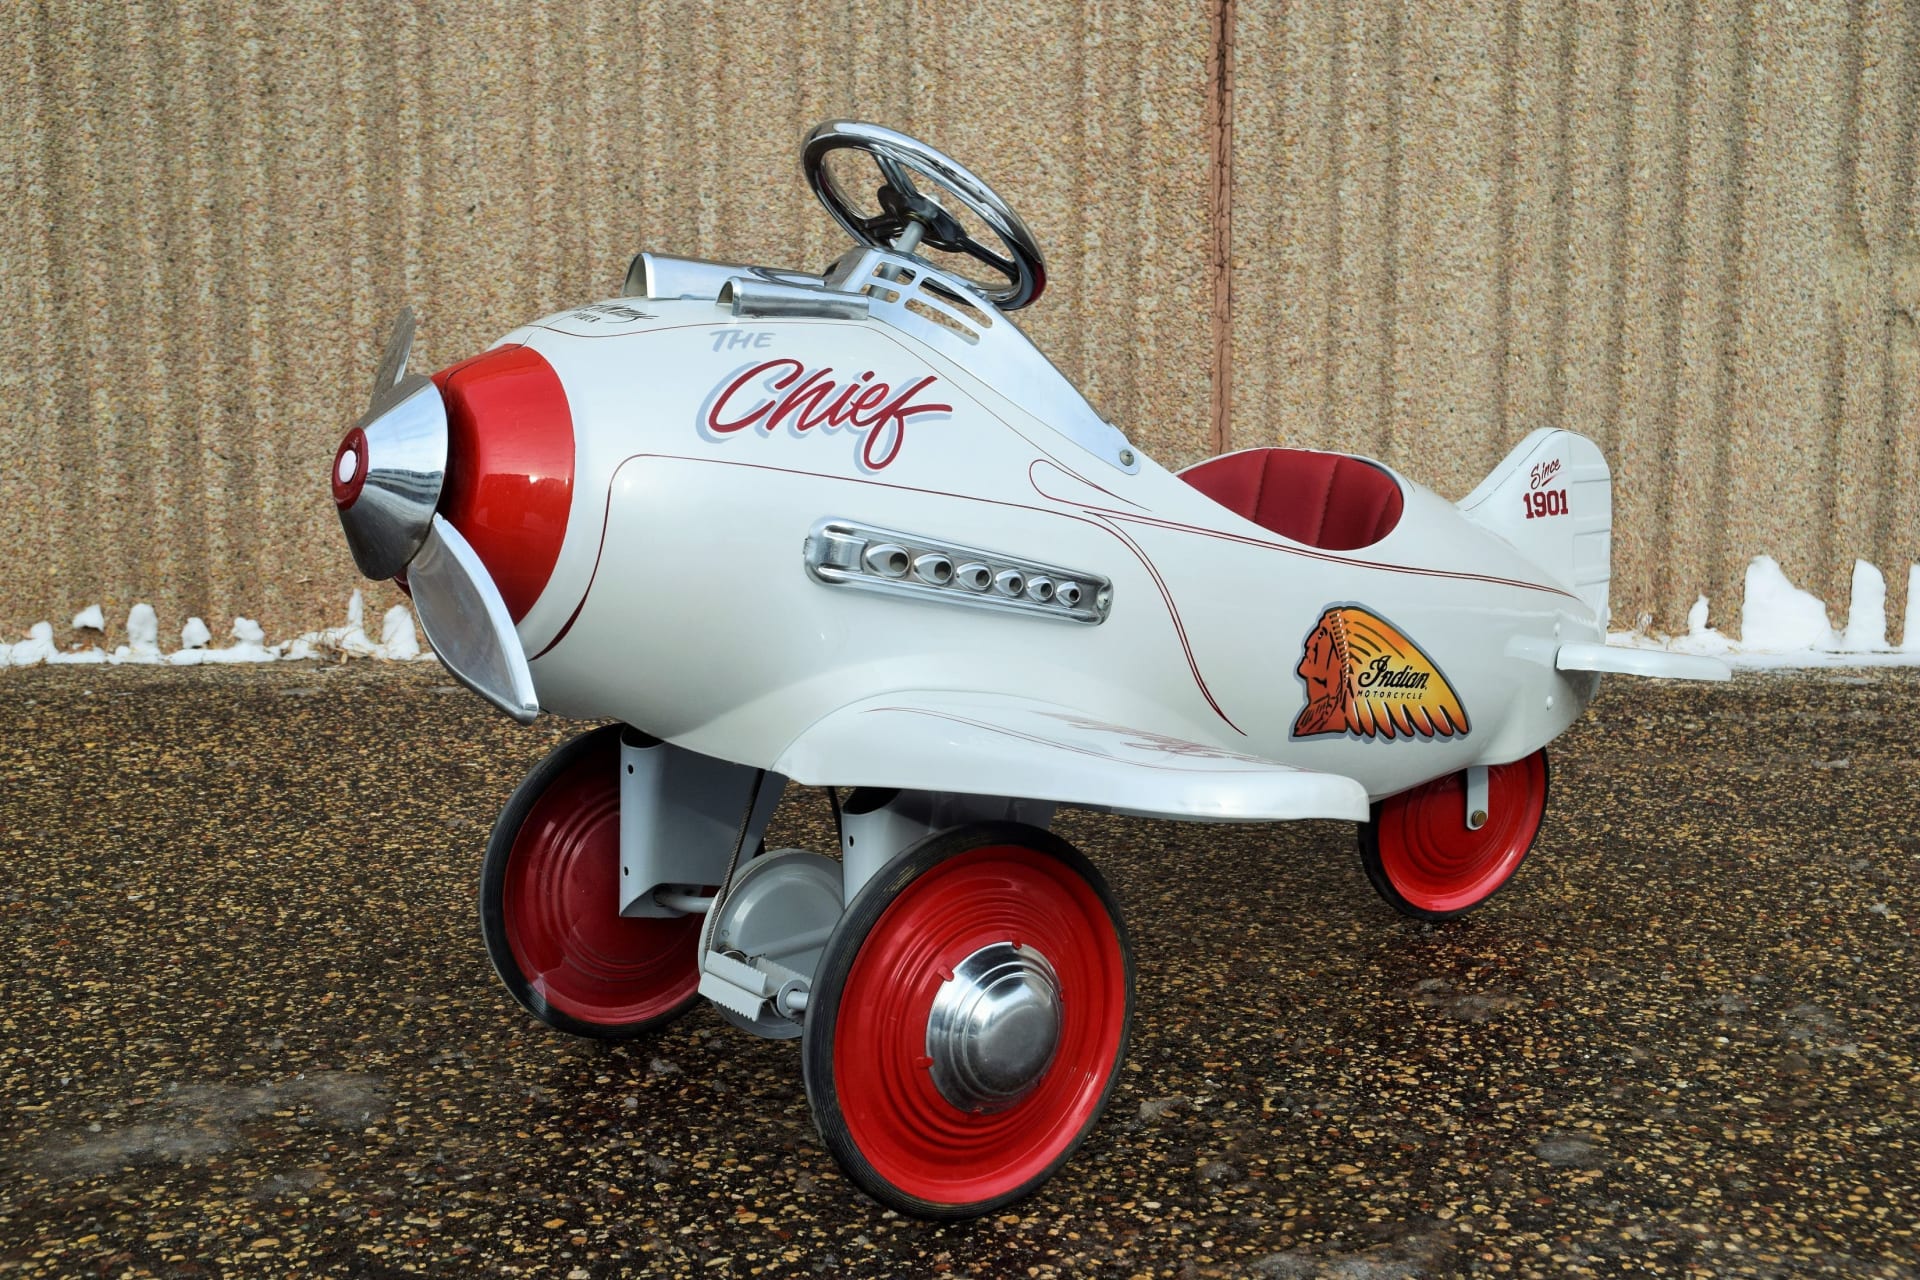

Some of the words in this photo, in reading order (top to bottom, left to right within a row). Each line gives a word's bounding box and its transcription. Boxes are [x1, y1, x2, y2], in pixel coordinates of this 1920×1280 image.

[710, 329, 776, 352] THE
[704, 358, 953, 471] Chief
[1530, 458, 1561, 490] Since
[1523, 489, 1569, 519] 1901
[1357, 655, 1430, 690] Indian
[1356, 689, 1424, 700] MOTORCYCLE
